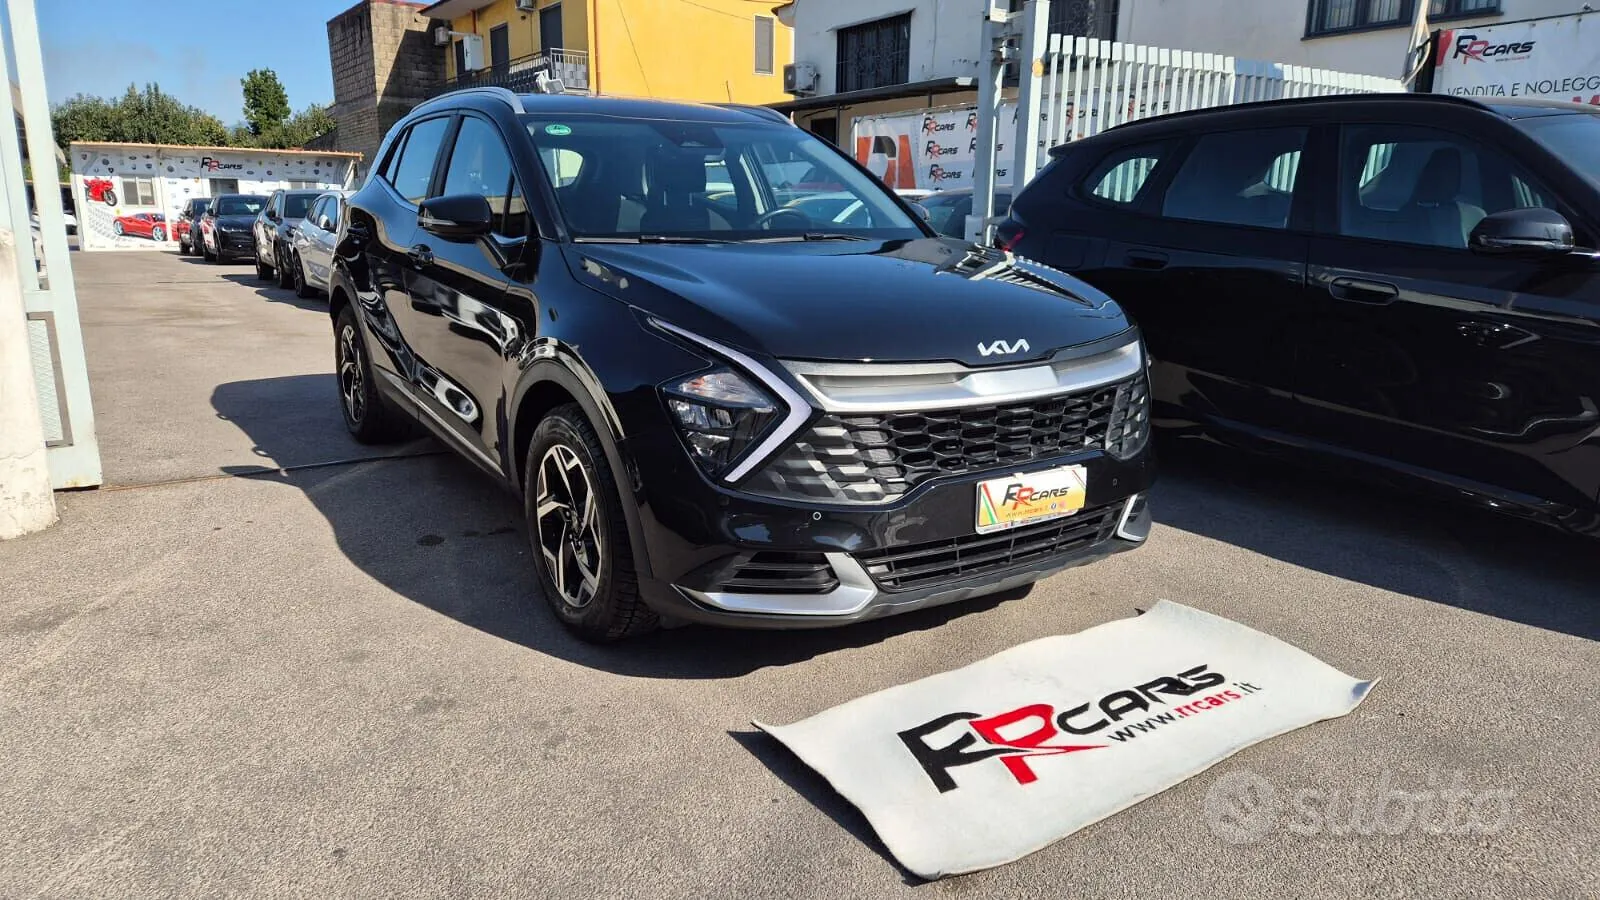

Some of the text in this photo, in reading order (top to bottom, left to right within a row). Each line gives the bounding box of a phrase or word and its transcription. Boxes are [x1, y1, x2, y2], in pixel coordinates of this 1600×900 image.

[1447, 84, 1505, 97] VENDITA
[1511, 83, 1520, 96] E
[977, 338, 1030, 356] KIA
[1107, 681, 1262, 742] www.rrcars.it
